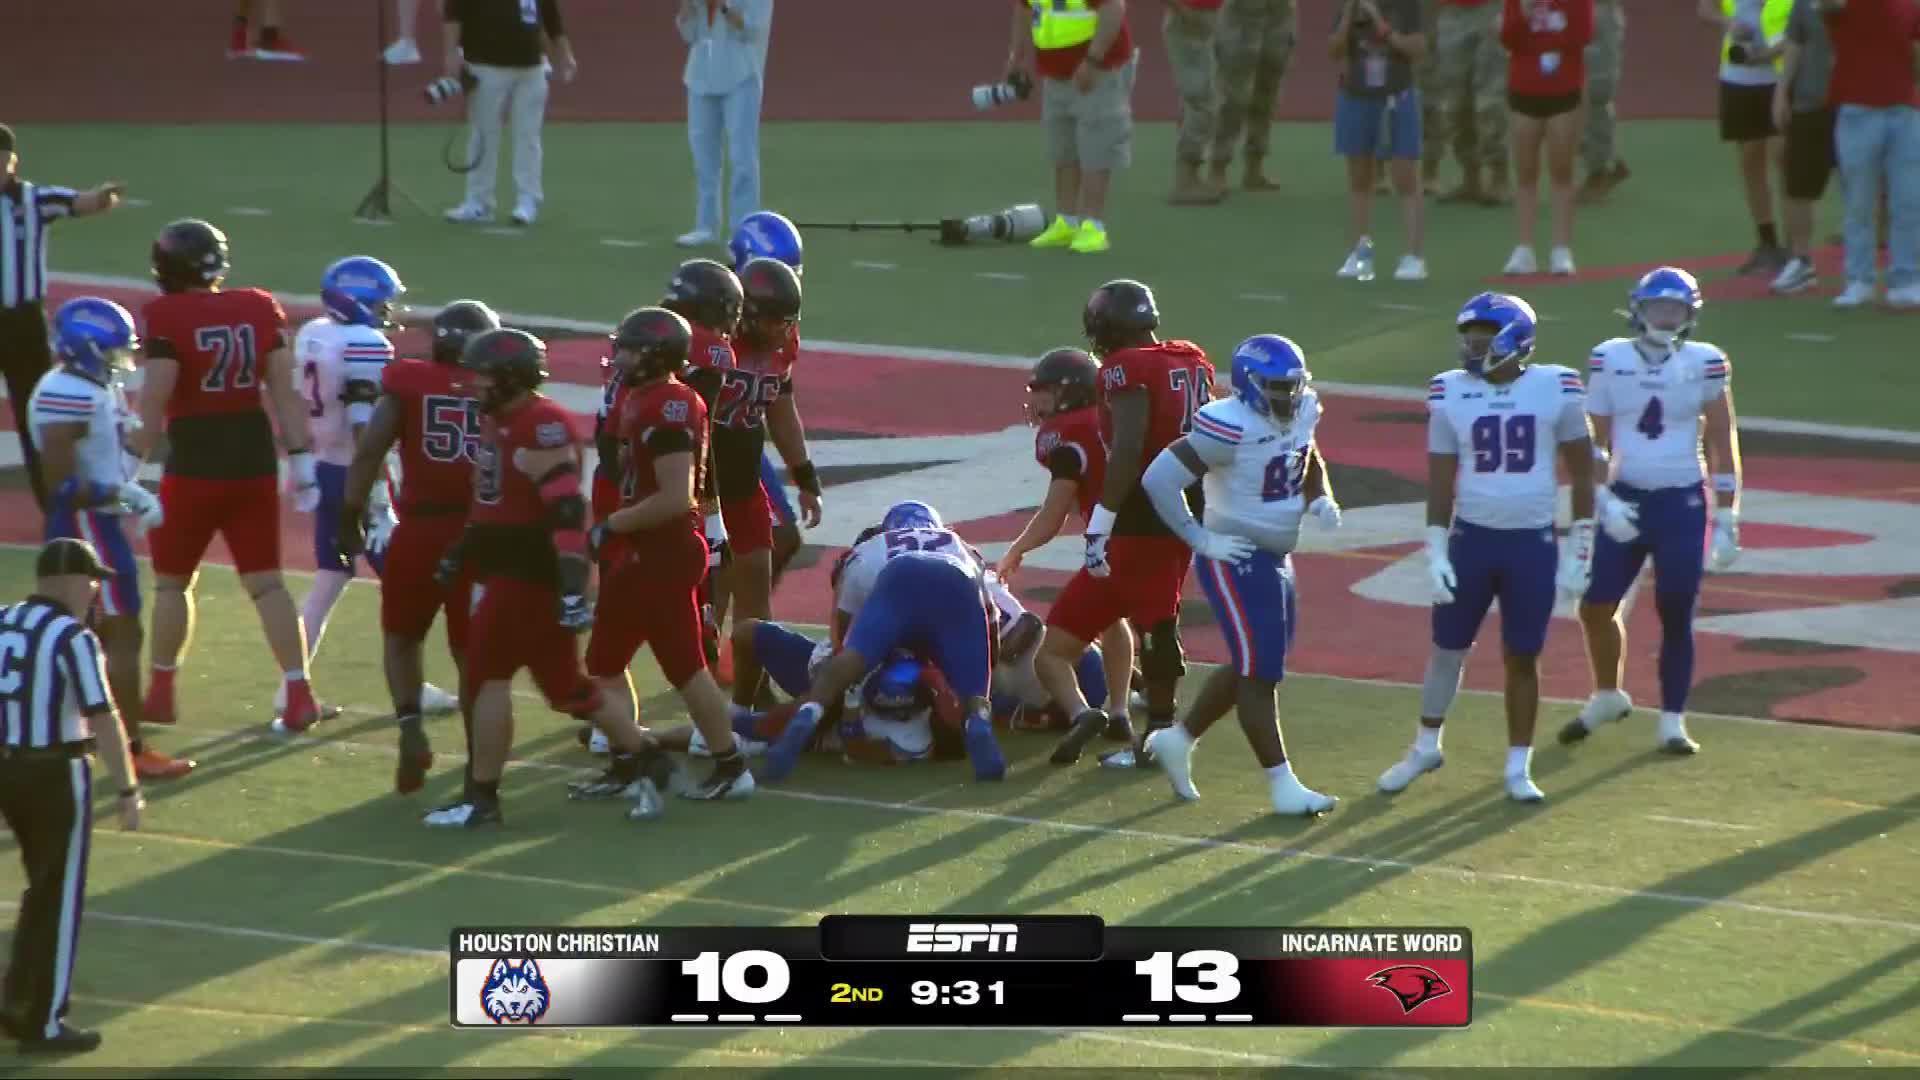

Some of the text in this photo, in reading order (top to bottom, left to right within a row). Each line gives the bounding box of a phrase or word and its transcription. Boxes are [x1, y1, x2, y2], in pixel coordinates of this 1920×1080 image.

[195, 324, 256, 392] 71
[1472, 414, 1537, 473] 99
[1636, 395, 1665, 440] 4
[0, 630, 28, 694] C
